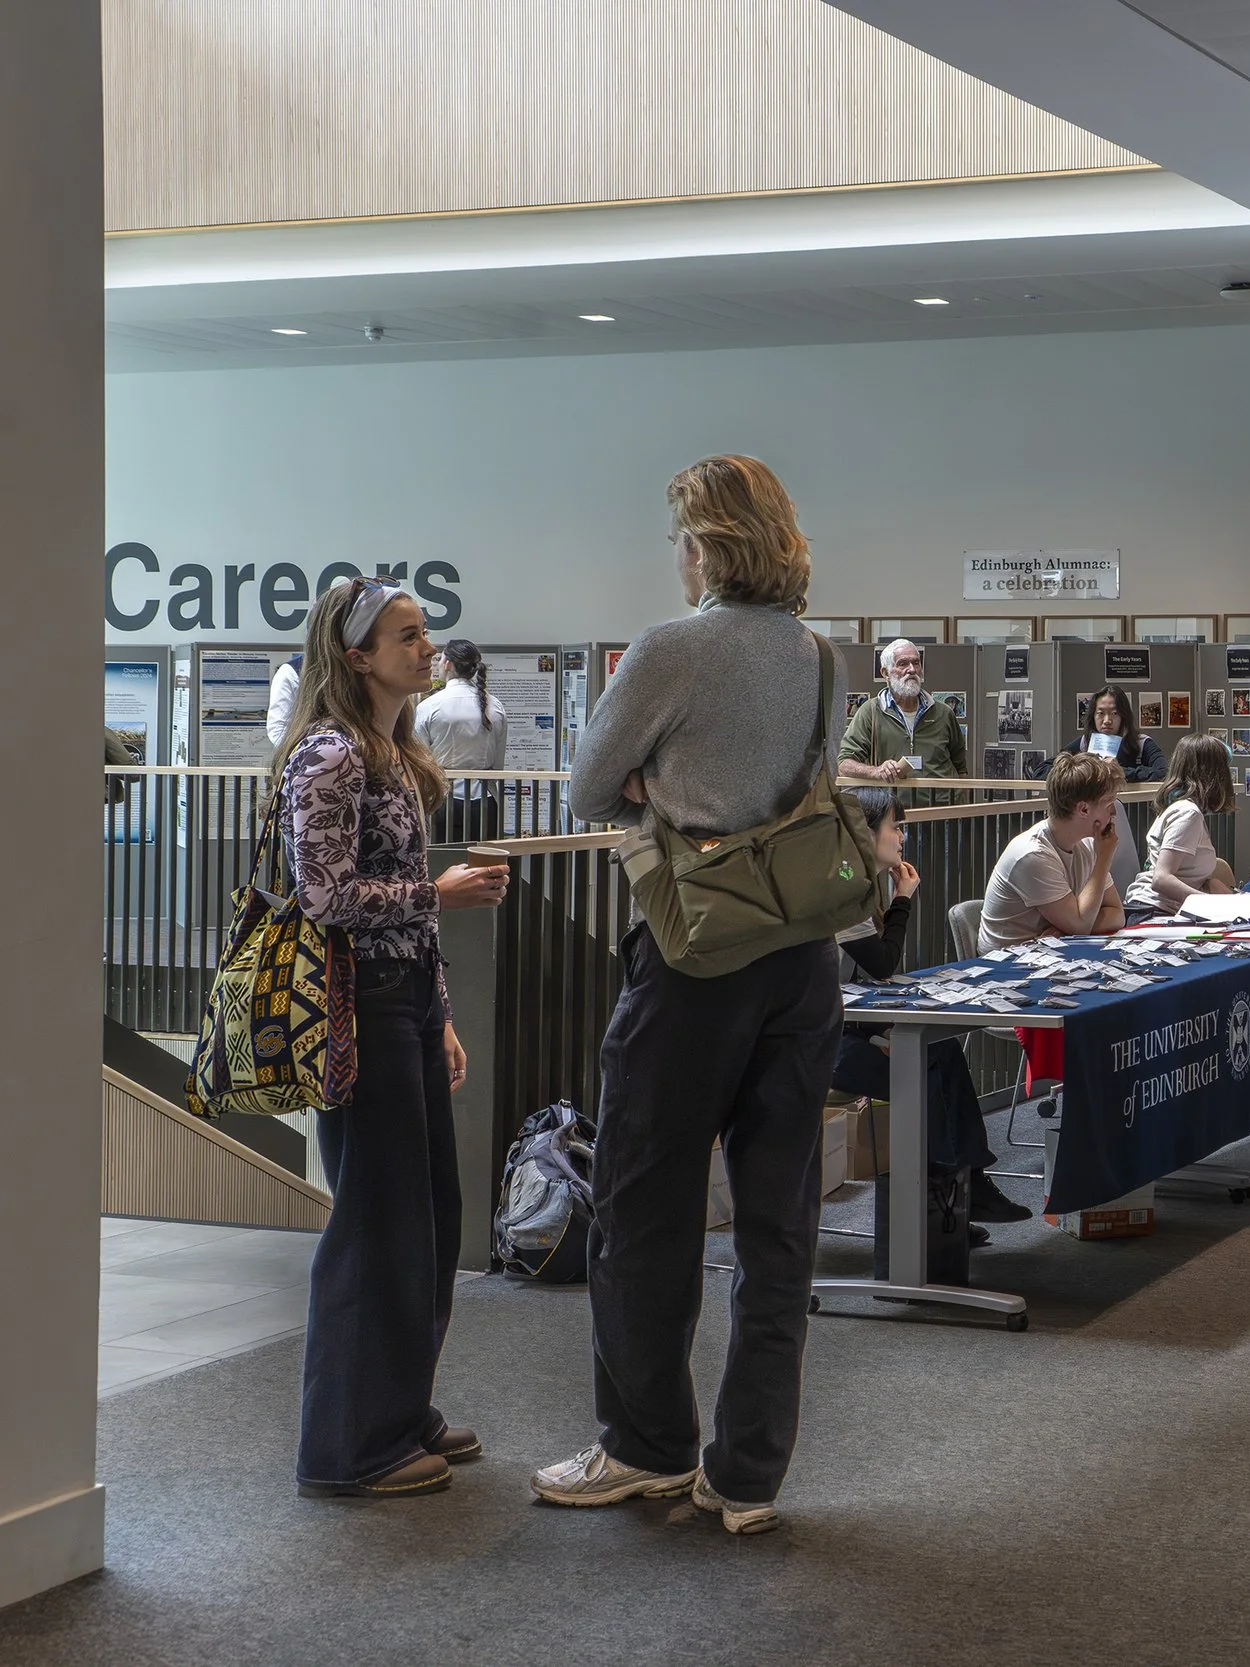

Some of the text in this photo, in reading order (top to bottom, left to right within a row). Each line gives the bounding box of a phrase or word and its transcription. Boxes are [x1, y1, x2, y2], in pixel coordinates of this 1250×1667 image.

[971, 558, 1111, 574] Edinburgh Alumnae:
[982, 579, 992, 591] a
[1111, 1036, 1141, 1073] THE
[1144, 1009, 1220, 1061] UNIVERSITY
[1123, 1053, 1220, 1128] of EDINBURGH
